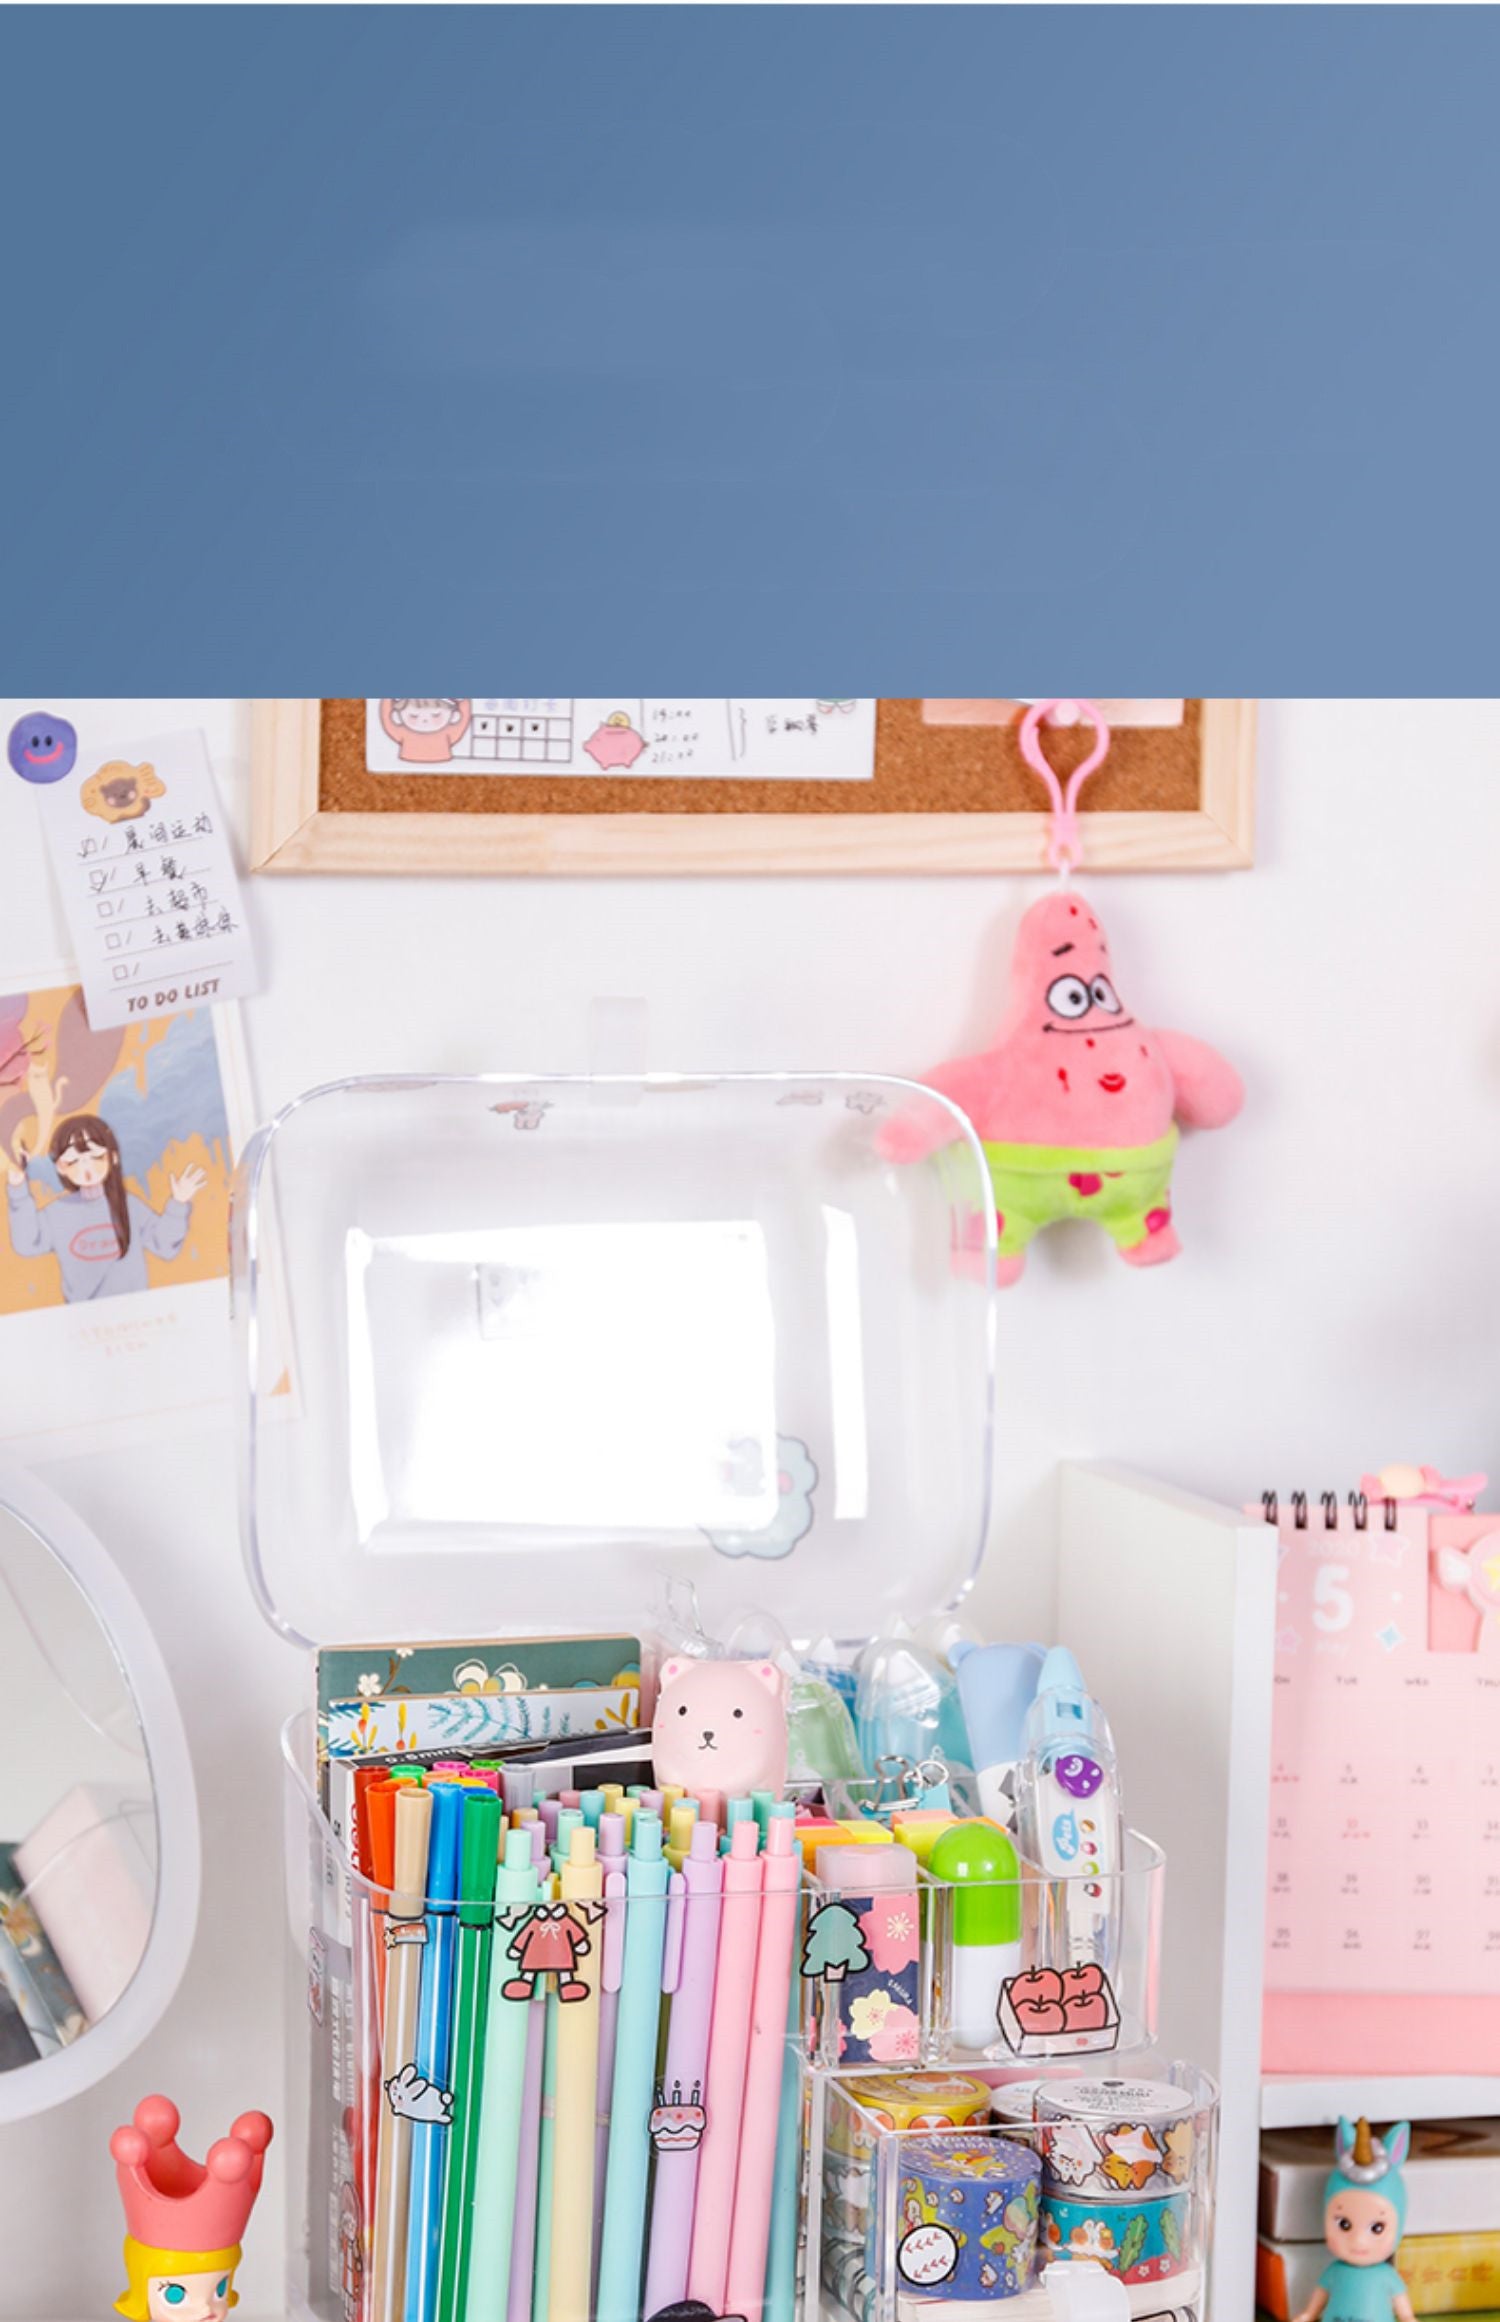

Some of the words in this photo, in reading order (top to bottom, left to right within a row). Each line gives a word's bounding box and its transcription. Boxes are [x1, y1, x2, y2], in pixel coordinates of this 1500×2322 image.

[127, 995, 149, 1014] TO
[154, 988, 179, 1007] DO
[184, 978, 221, 1000] LIST
[1312, 1565, 1354, 1632] 5
